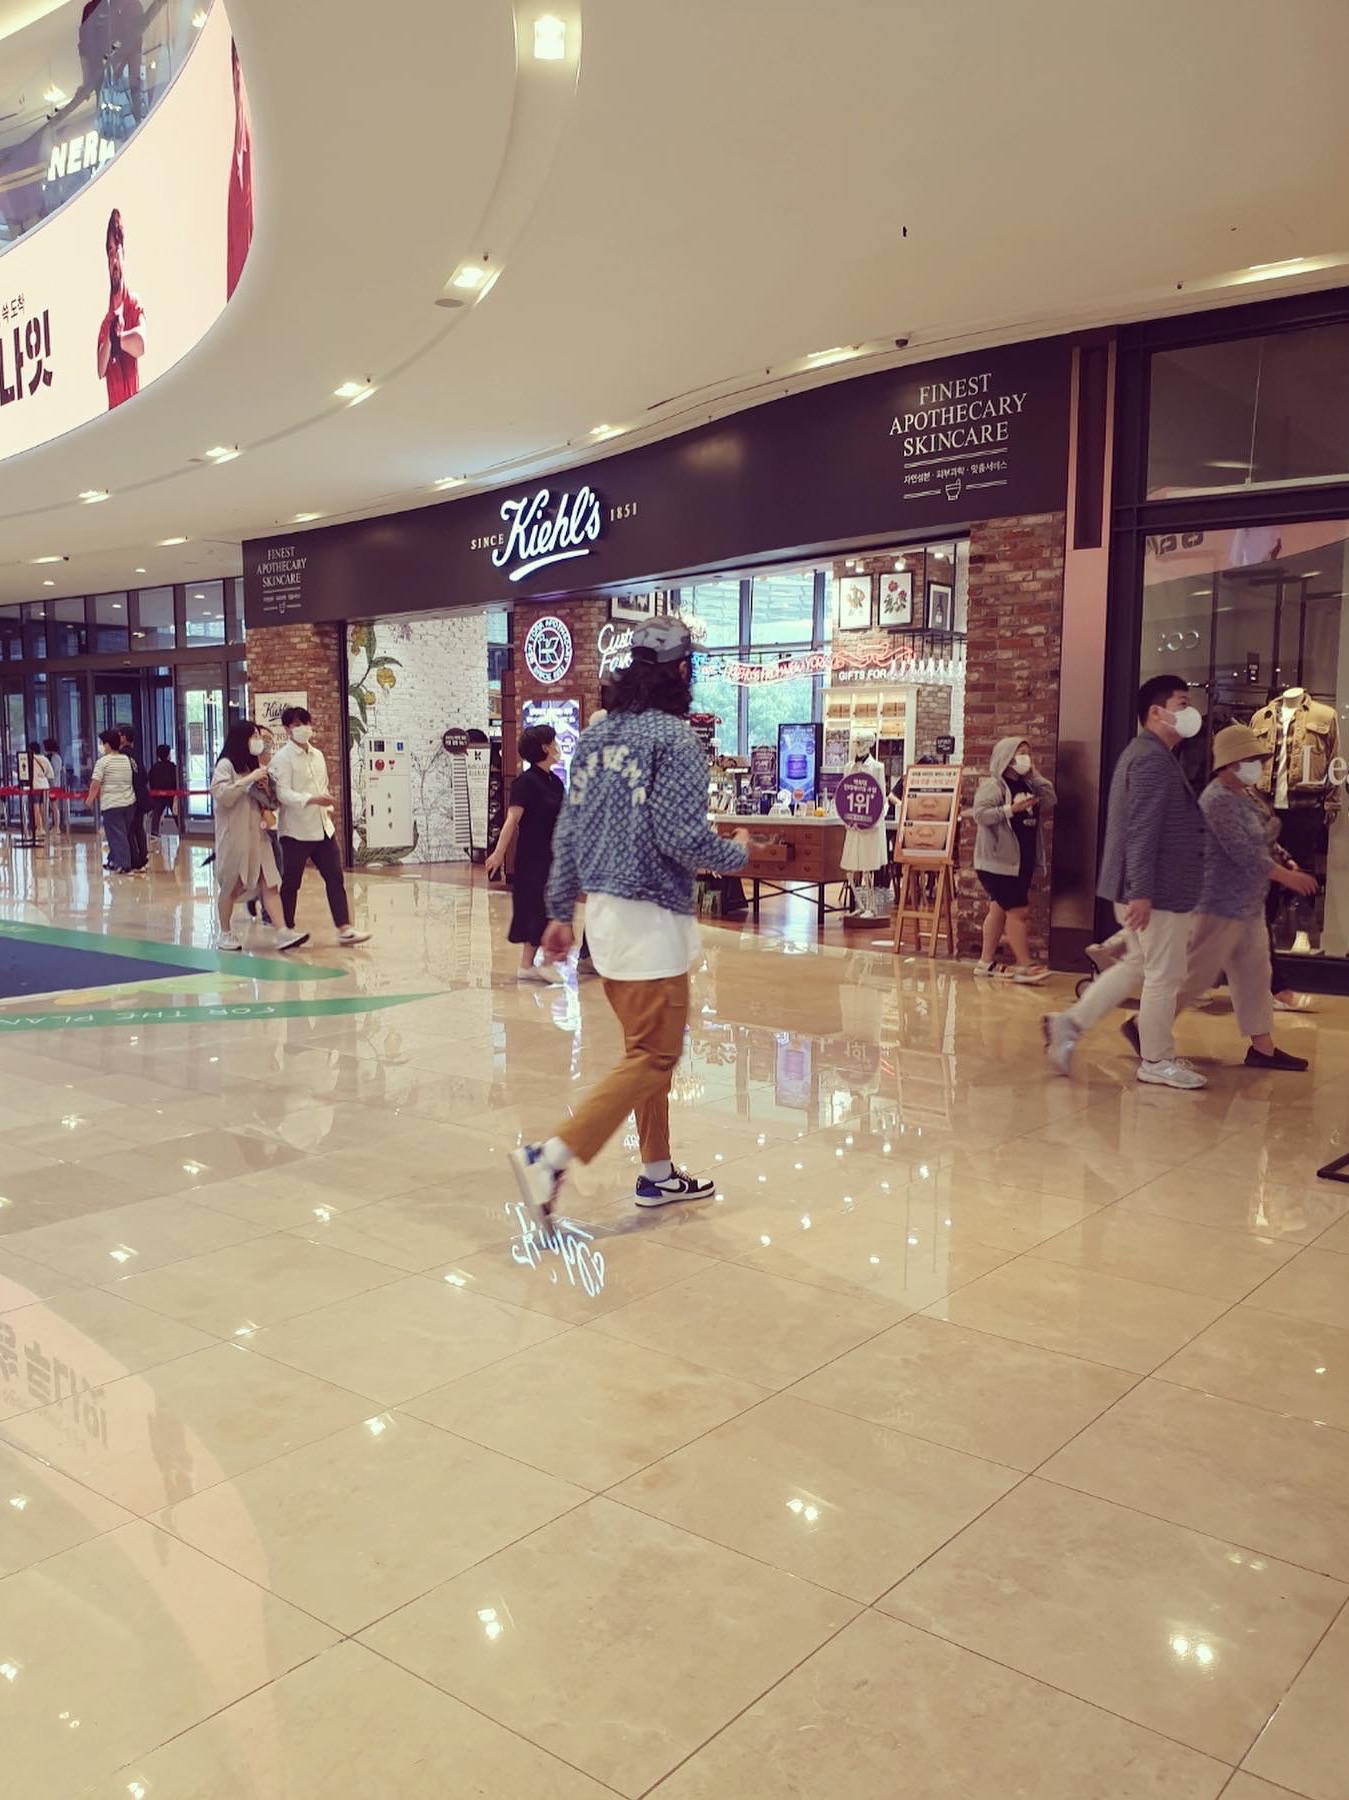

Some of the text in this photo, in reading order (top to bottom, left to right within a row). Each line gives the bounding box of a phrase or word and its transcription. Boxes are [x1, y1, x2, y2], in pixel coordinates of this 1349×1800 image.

[920, 373, 992, 406] FINEST
[889, 392, 1027, 436] APOTHECARY
[903, 421, 1009, 457] SKINCARE
[470, 486, 638, 567] SINCE Kiehl's 1851
[256, 558, 307, 575] APOTHECARY
[267, 546, 295, 560] FINEST
[262, 573, 301, 588] SKINCARE
[598, 623, 636, 655] Cust
[839, 668, 887, 681] GIFTS FOR
[1297, 744, 1349, 786] Le
